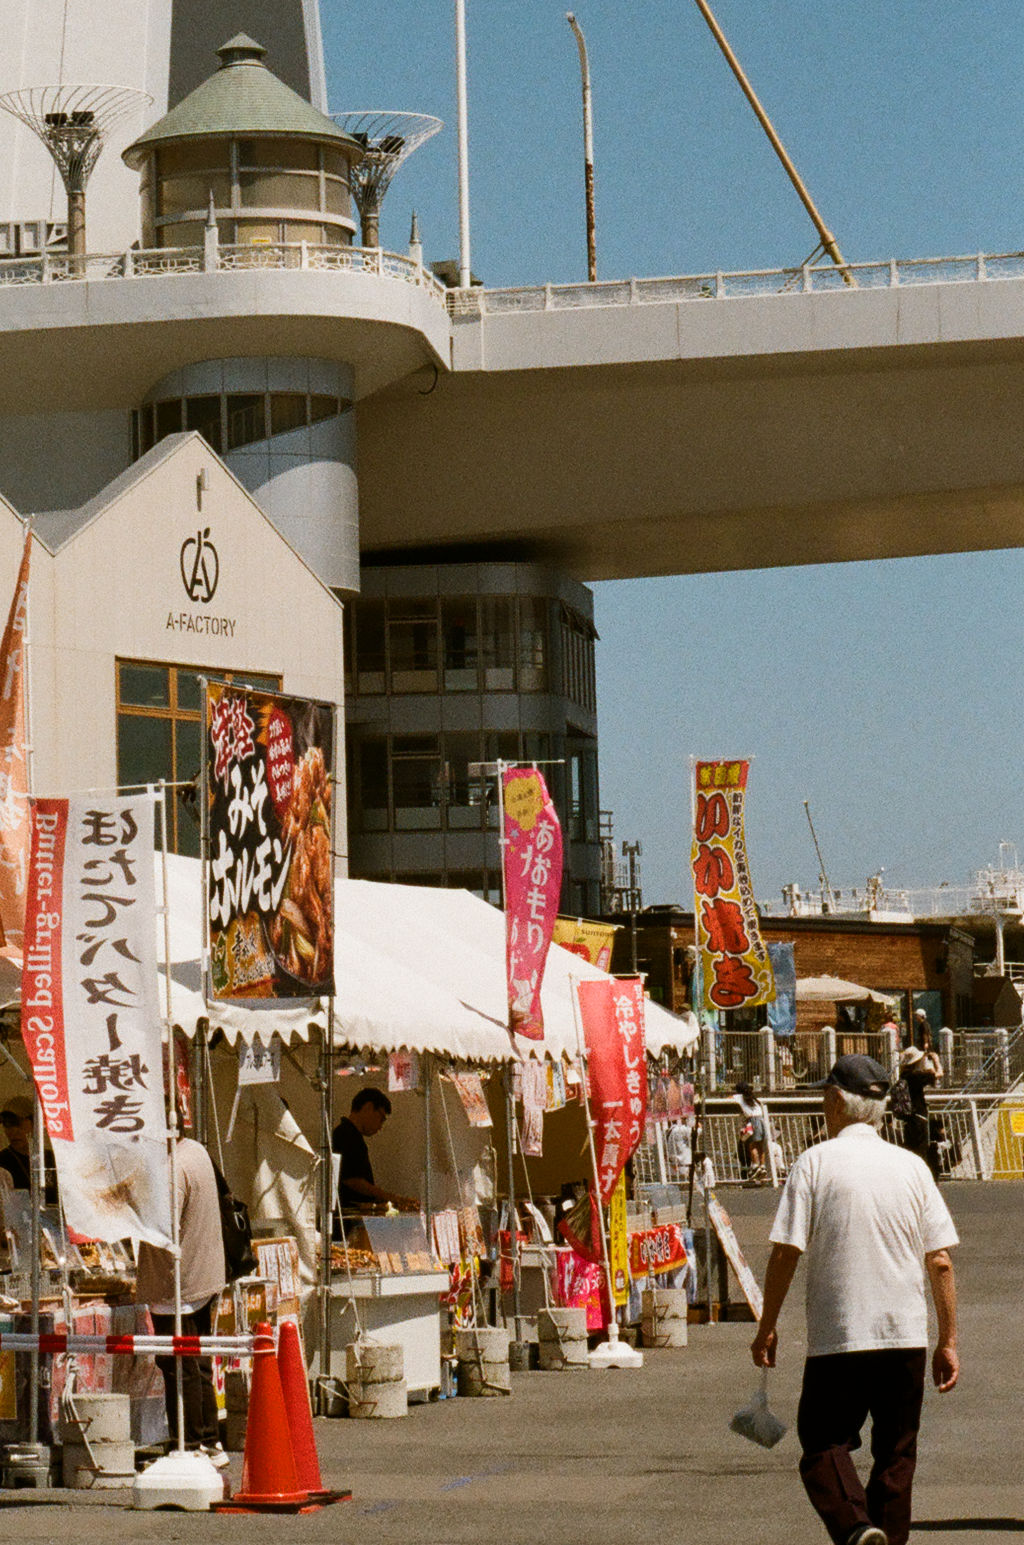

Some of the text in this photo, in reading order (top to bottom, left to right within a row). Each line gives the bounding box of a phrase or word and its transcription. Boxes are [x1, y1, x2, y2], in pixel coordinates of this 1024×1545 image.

[165, 612, 236, 638] A-FACTORY
[227, 758, 269, 840] みそ
[210, 828, 293, 928] ホルモン
[692, 791, 759, 1008] いか焼き
